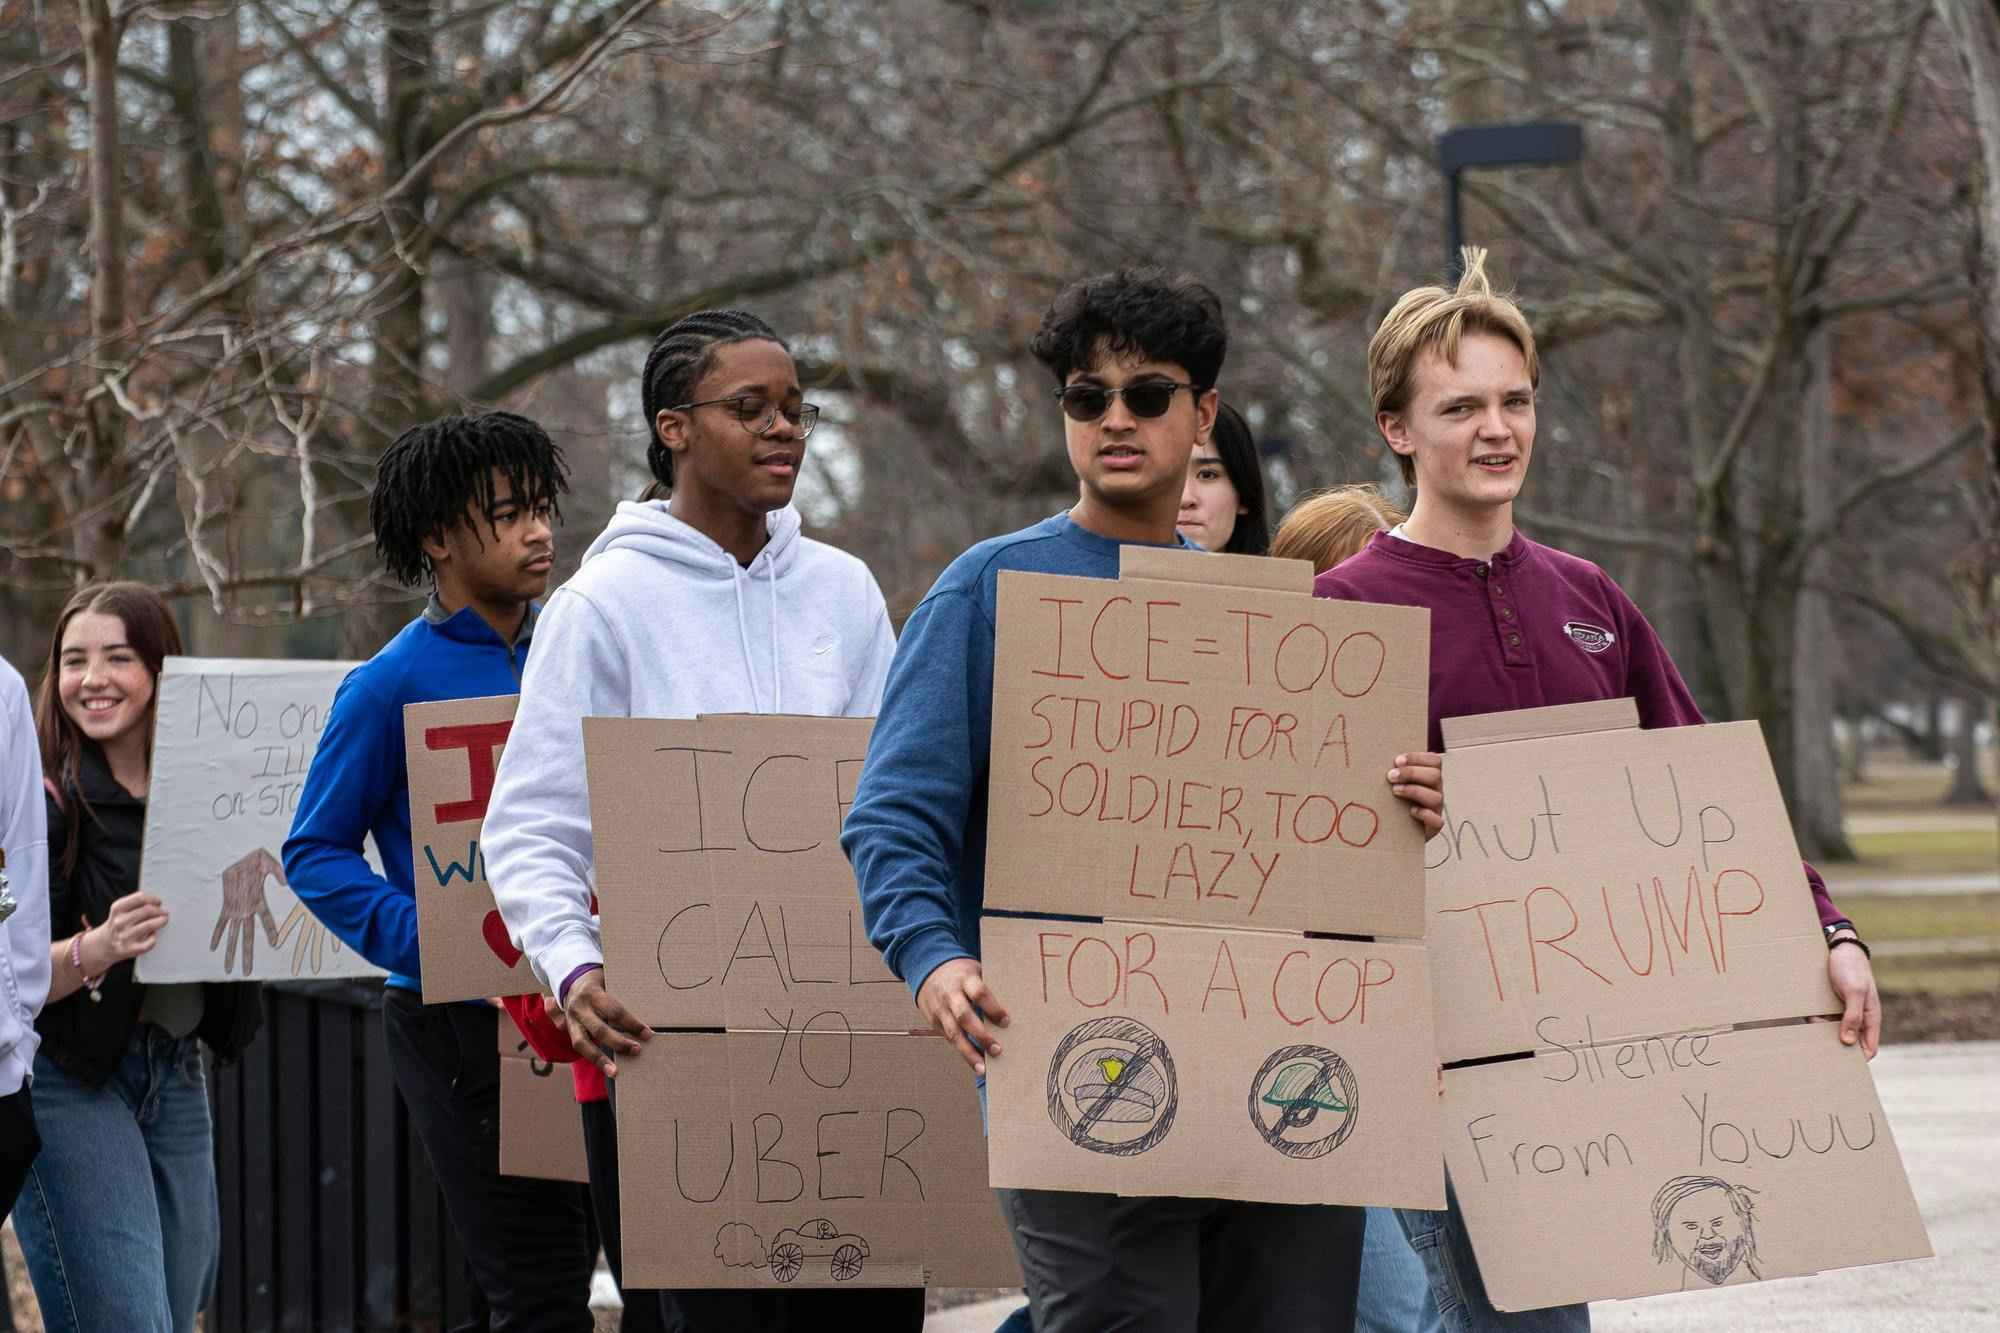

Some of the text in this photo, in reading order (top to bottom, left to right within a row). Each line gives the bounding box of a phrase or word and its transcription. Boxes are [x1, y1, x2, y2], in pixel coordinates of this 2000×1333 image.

[195, 671, 258, 739] No
[1024, 694, 1350, 768] STUPID FOR A
[211, 788, 245, 821] on
[1028, 756, 1379, 848] SOLDIER, TOO
[1624, 763, 1735, 872] Up
[1129, 842, 1281, 916] LAZY
[656, 900, 906, 993] CALL
[1437, 865, 1765, 1003] TRUMP
[1038, 931, 1396, 1026] FOR A COP
[763, 1008, 853, 1089] YO
[1534, 1014, 1721, 1083] Silence
[674, 1107, 926, 1204] UBER
[1467, 1112, 1633, 1183] From
